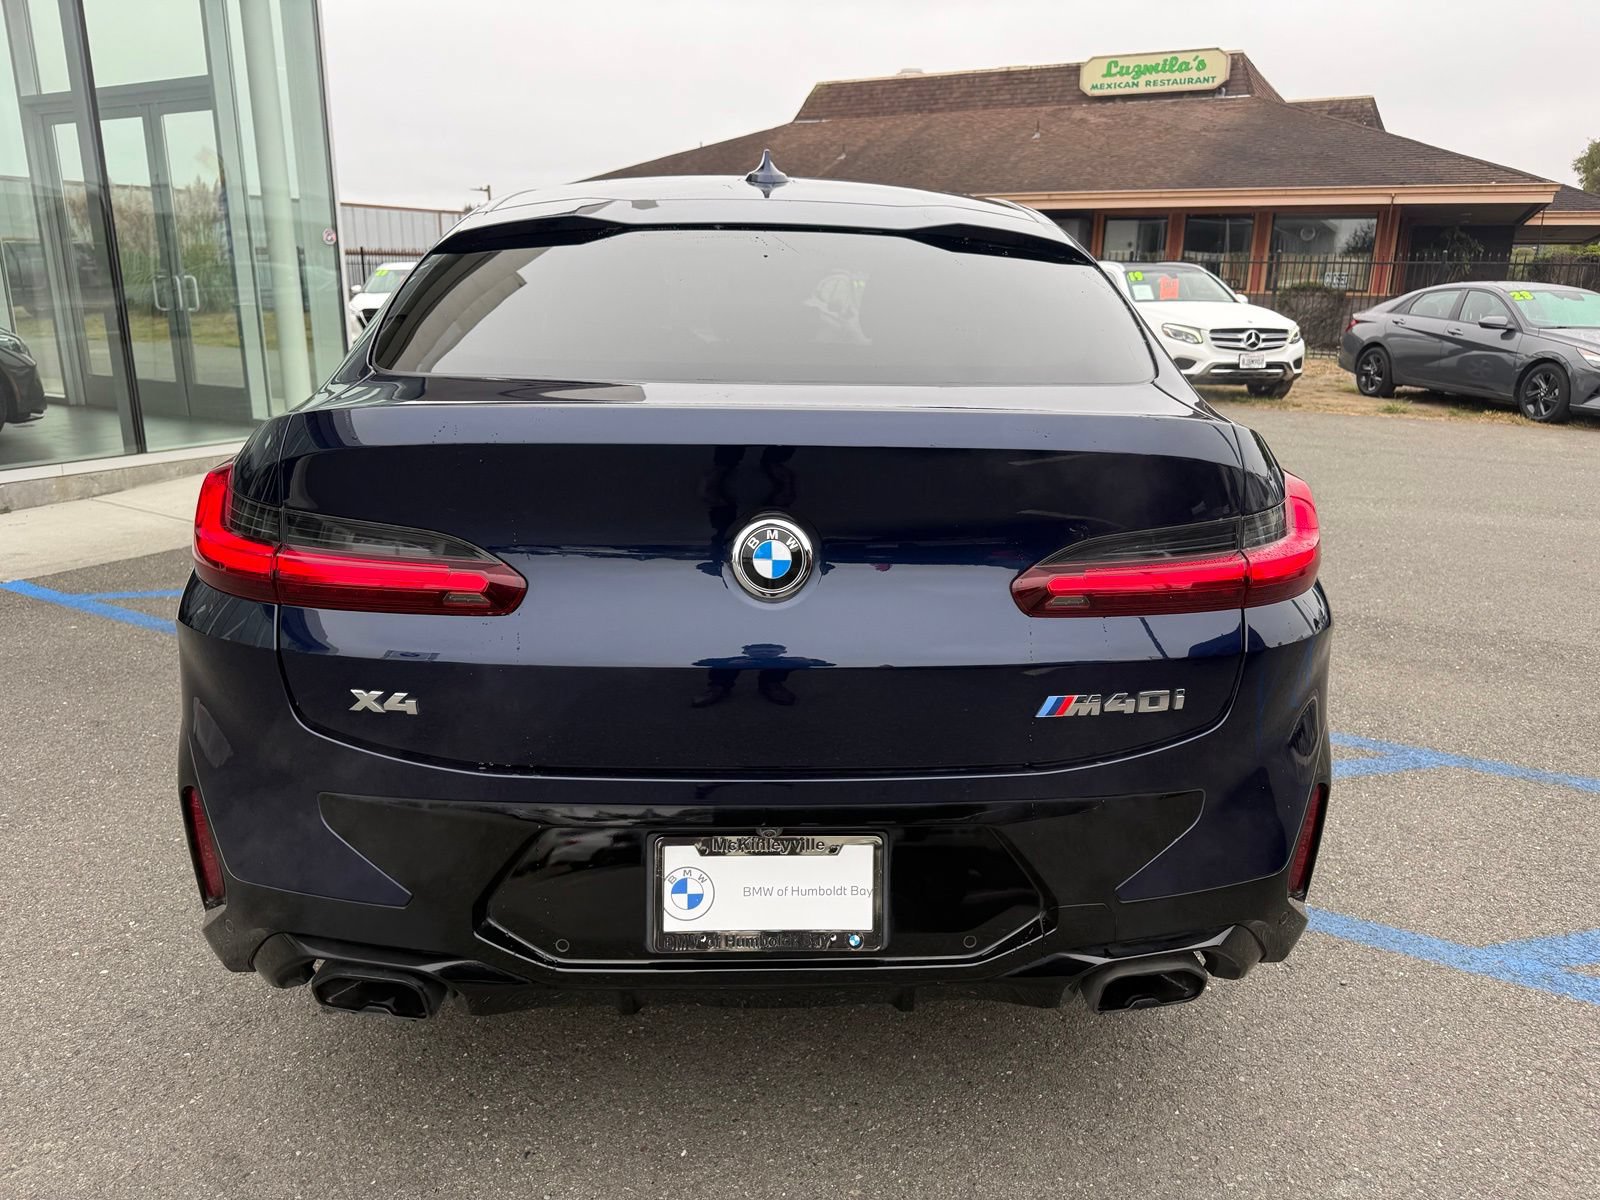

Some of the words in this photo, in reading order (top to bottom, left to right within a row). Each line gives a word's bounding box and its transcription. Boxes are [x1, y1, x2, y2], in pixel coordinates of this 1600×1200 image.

[1101, 55, 1207, 80] Luzmila's
[1090, 81, 1139, 91] MEXICAN
[1145, 76, 1217, 88] RESTAURANT
[747, 529, 798, 550] BMW
[348, 689, 418, 715] X4
[1035, 688, 1185, 717] M40i
[711, 837, 826, 855] McKinleyville
[667, 869, 707, 885] BMW
[743, 886, 774, 897] BMW
[777, 886, 789, 897] of
[791, 886, 847, 897] Humboldt
[850, 885, 873, 898] Bay
